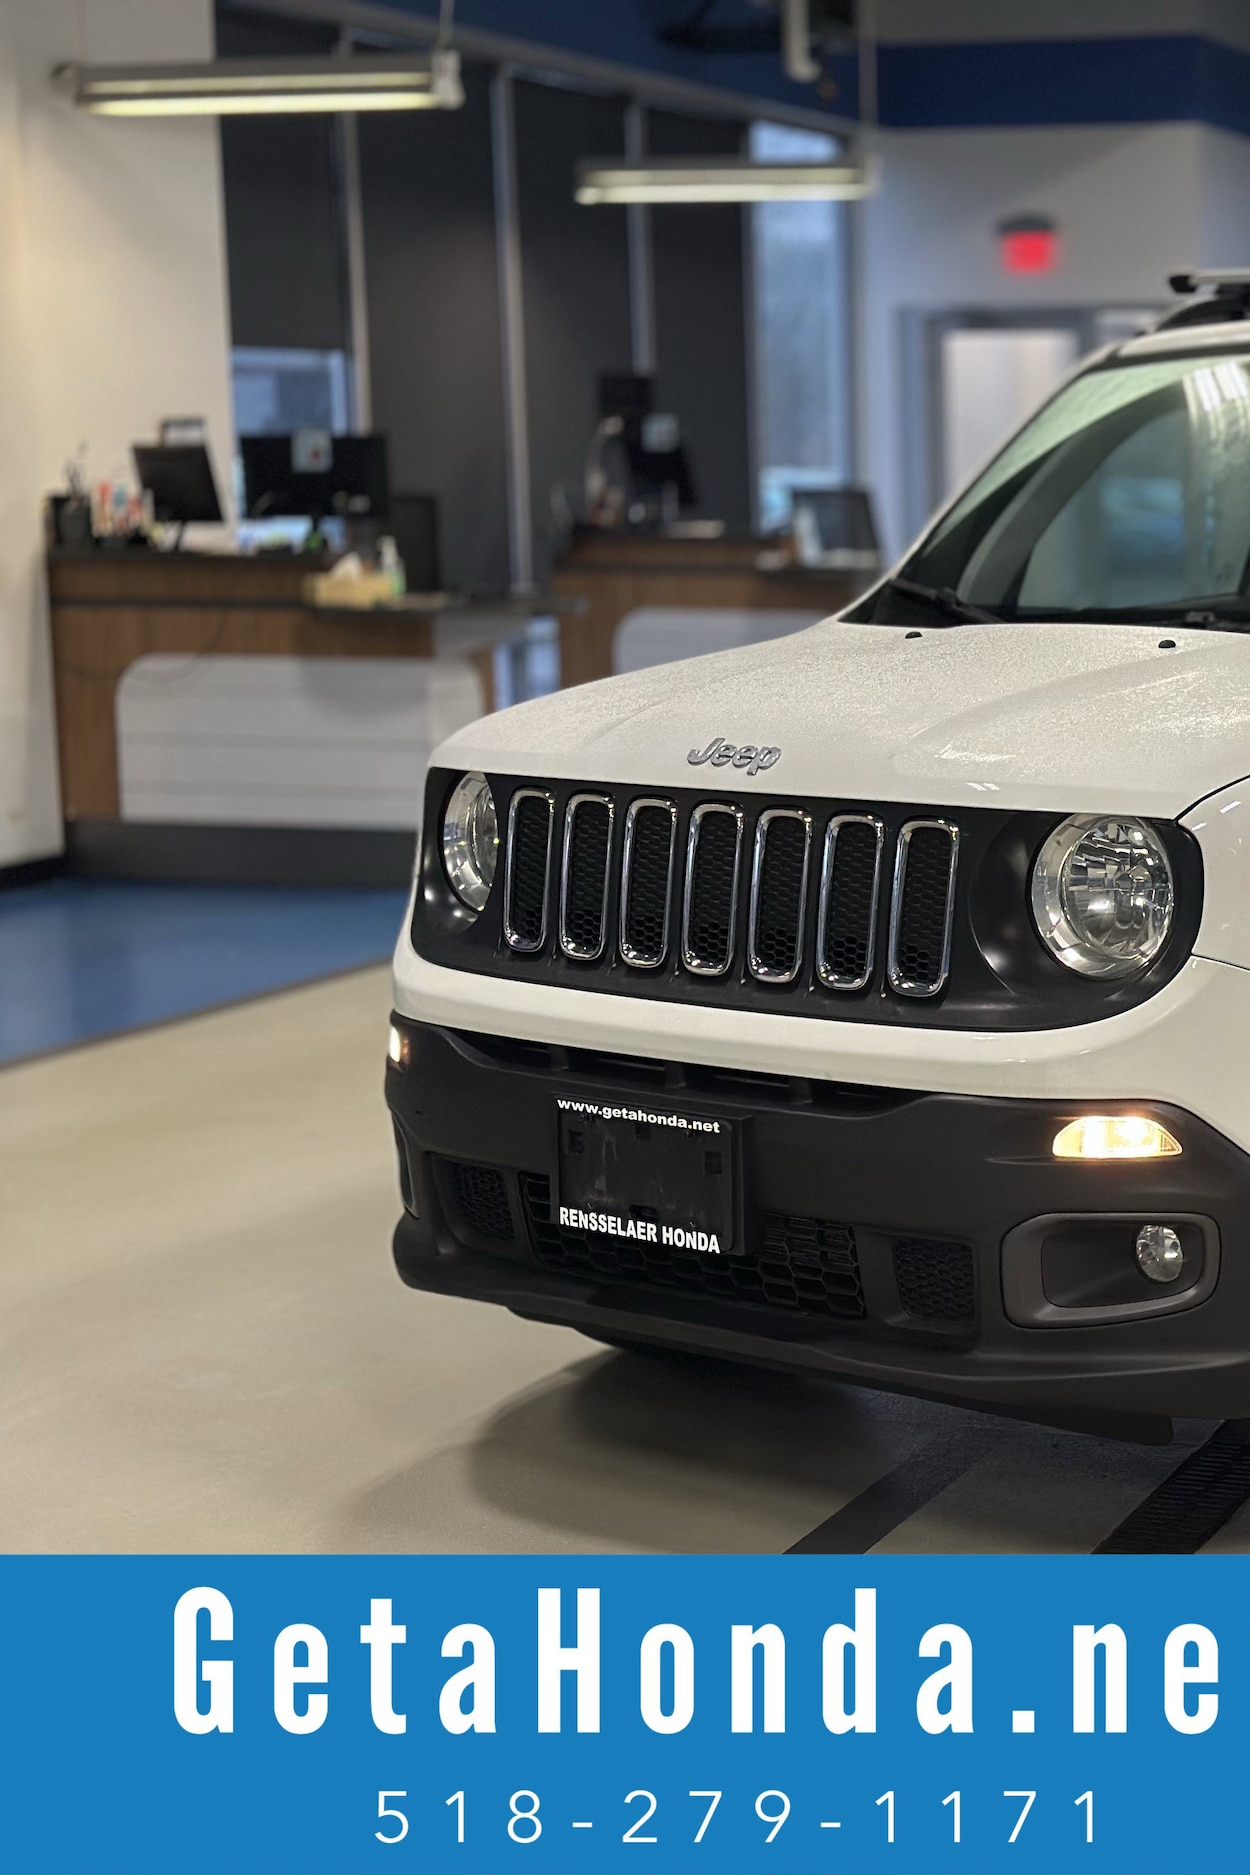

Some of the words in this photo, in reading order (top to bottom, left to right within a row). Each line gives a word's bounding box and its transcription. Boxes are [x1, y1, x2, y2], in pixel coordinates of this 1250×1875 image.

[687, 737, 782, 776] Jeep
[557, 1099, 721, 1134] www.getahonda.net
[559, 1206, 658, 1243] RENSSELAER
[661, 1225, 721, 1254] HONDA
